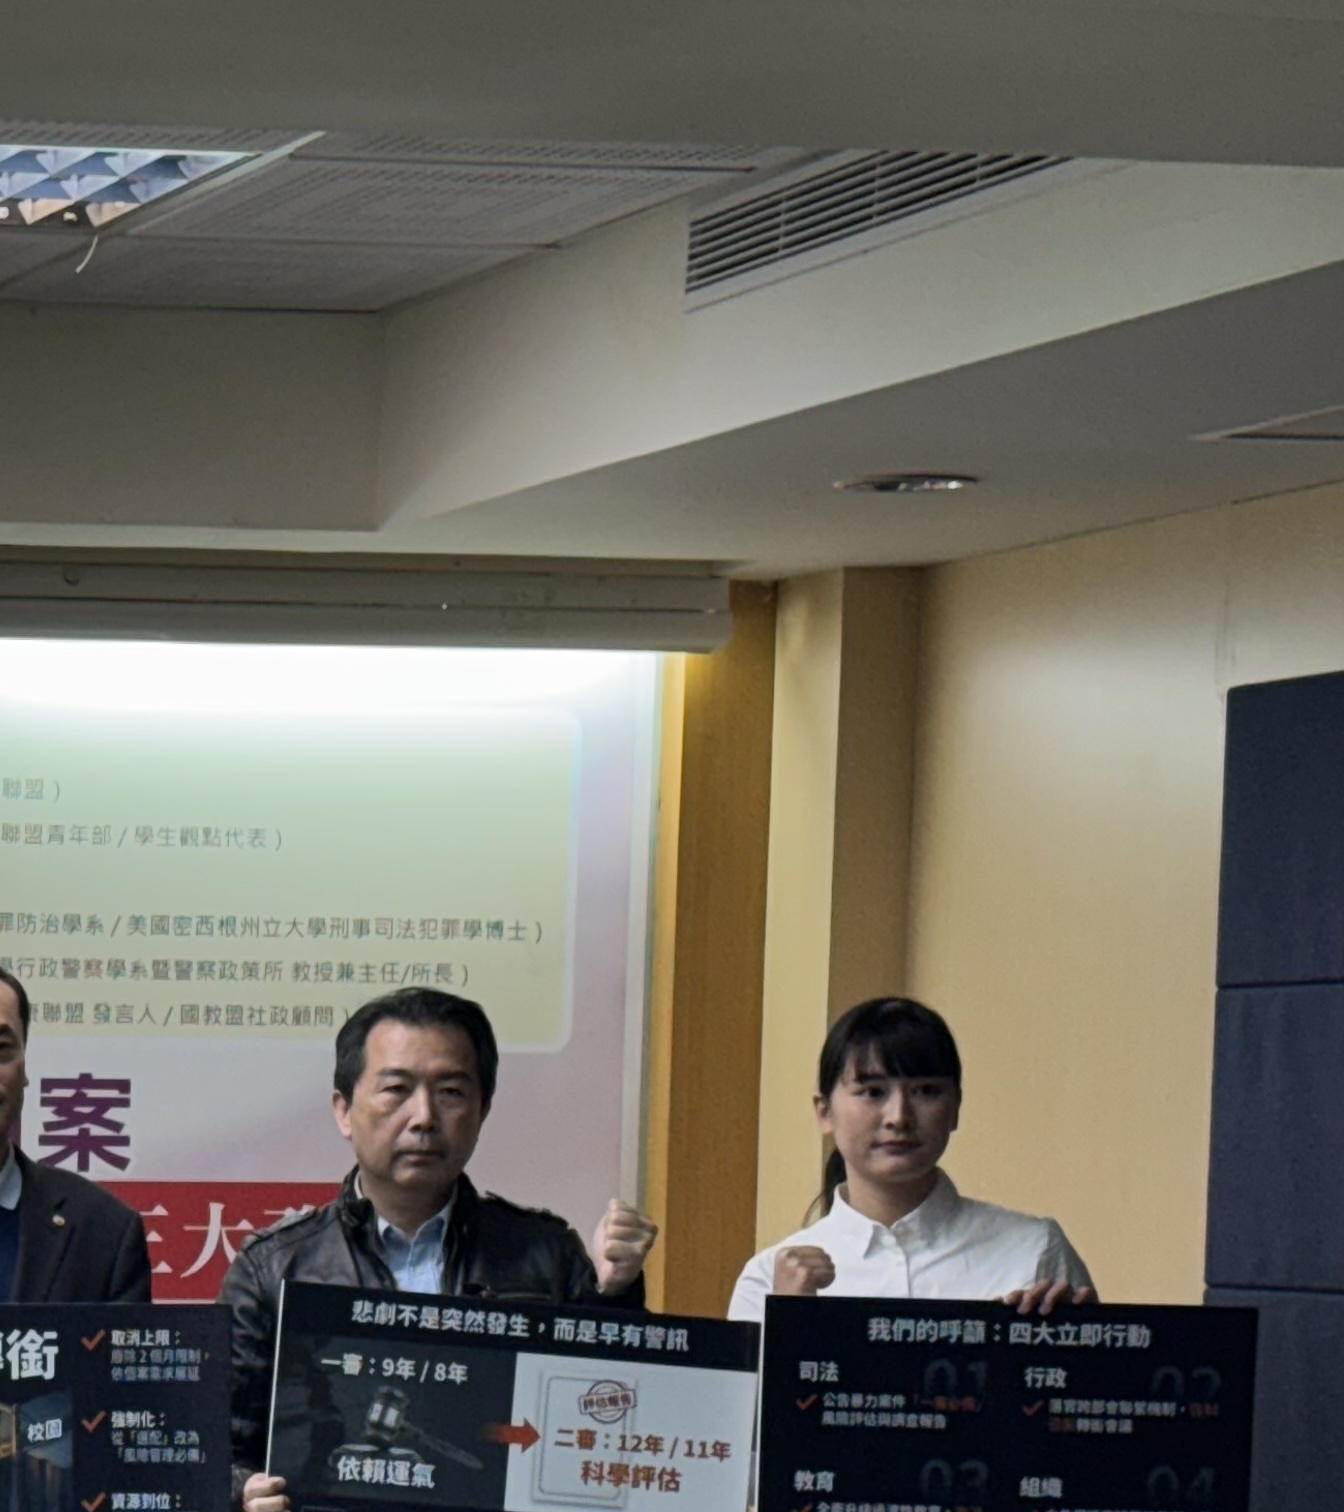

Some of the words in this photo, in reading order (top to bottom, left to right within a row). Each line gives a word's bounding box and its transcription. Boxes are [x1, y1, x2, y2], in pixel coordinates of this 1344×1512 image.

[799, 1361, 839, 1382] 司法
[1024, 1367, 1067, 1389] 行政
[336, 1457, 436, 1489] 依賴運氣
[580, 1460, 681, 1493] 科學評估
